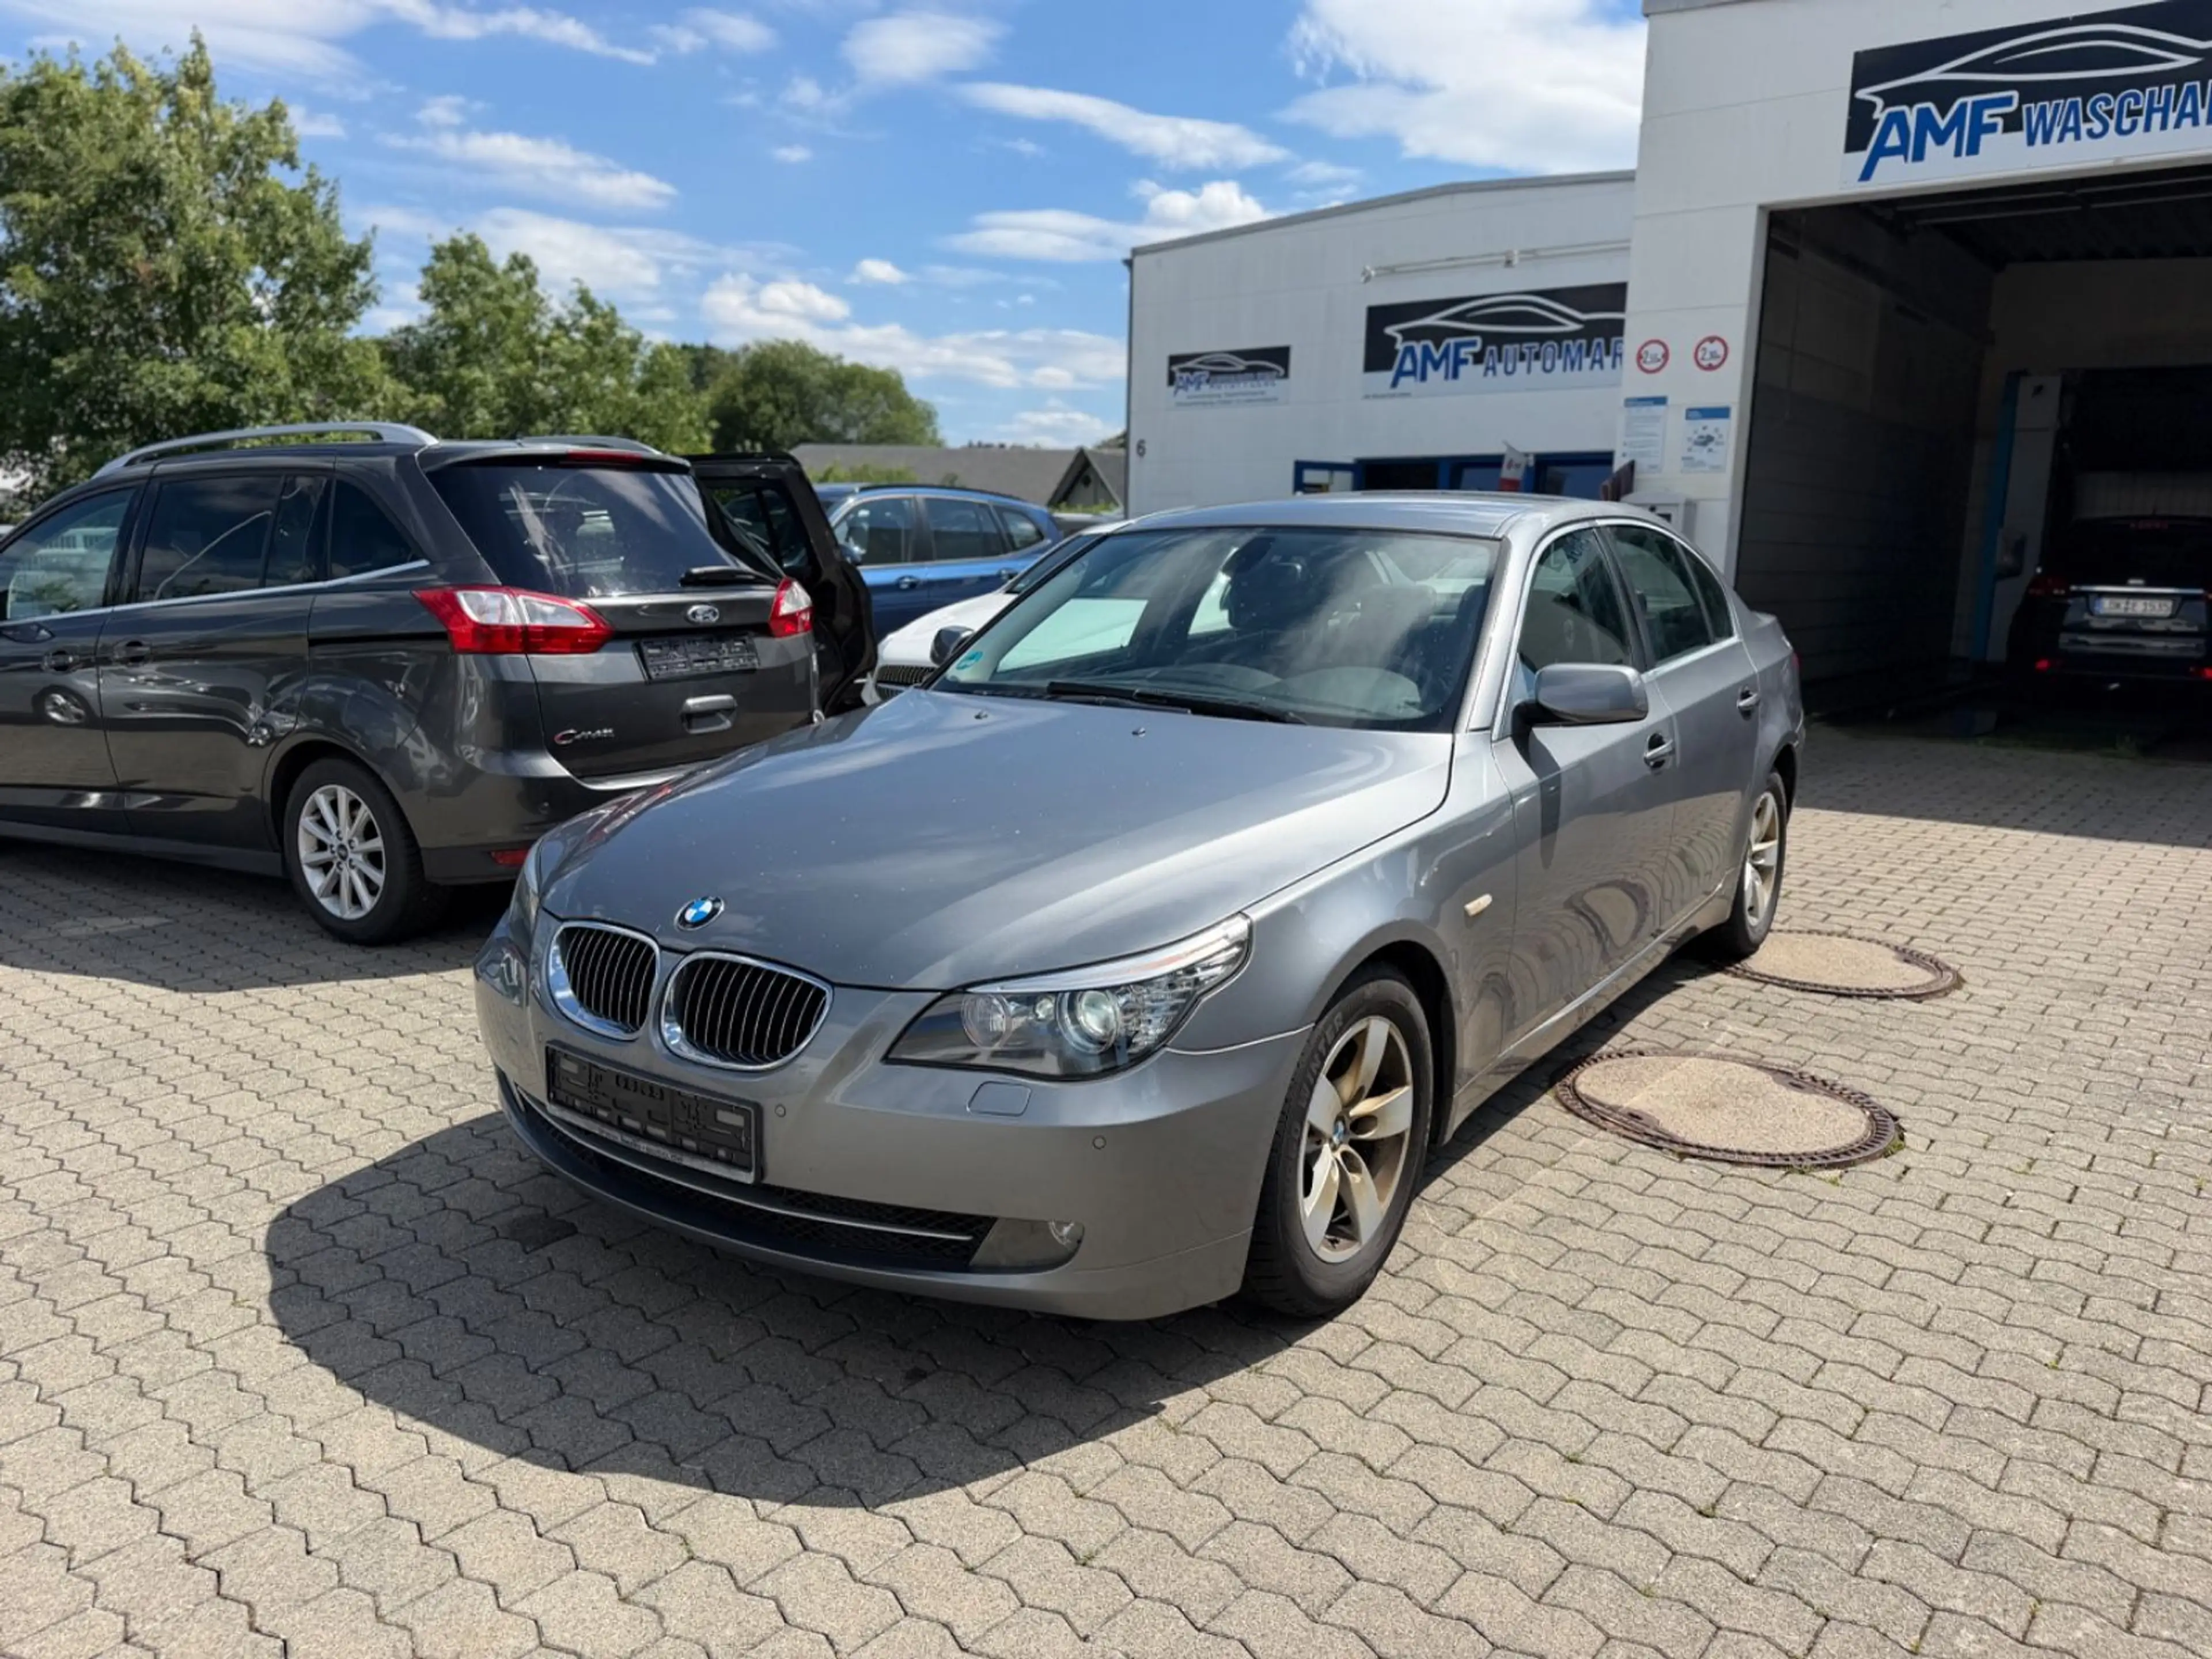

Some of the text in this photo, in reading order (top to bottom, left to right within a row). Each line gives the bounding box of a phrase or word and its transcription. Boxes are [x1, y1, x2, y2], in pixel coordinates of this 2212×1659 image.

[1858, 91, 2018, 182] AMF
[1389, 336, 1482, 389] AMF
[1136, 438, 1146, 459] 6
